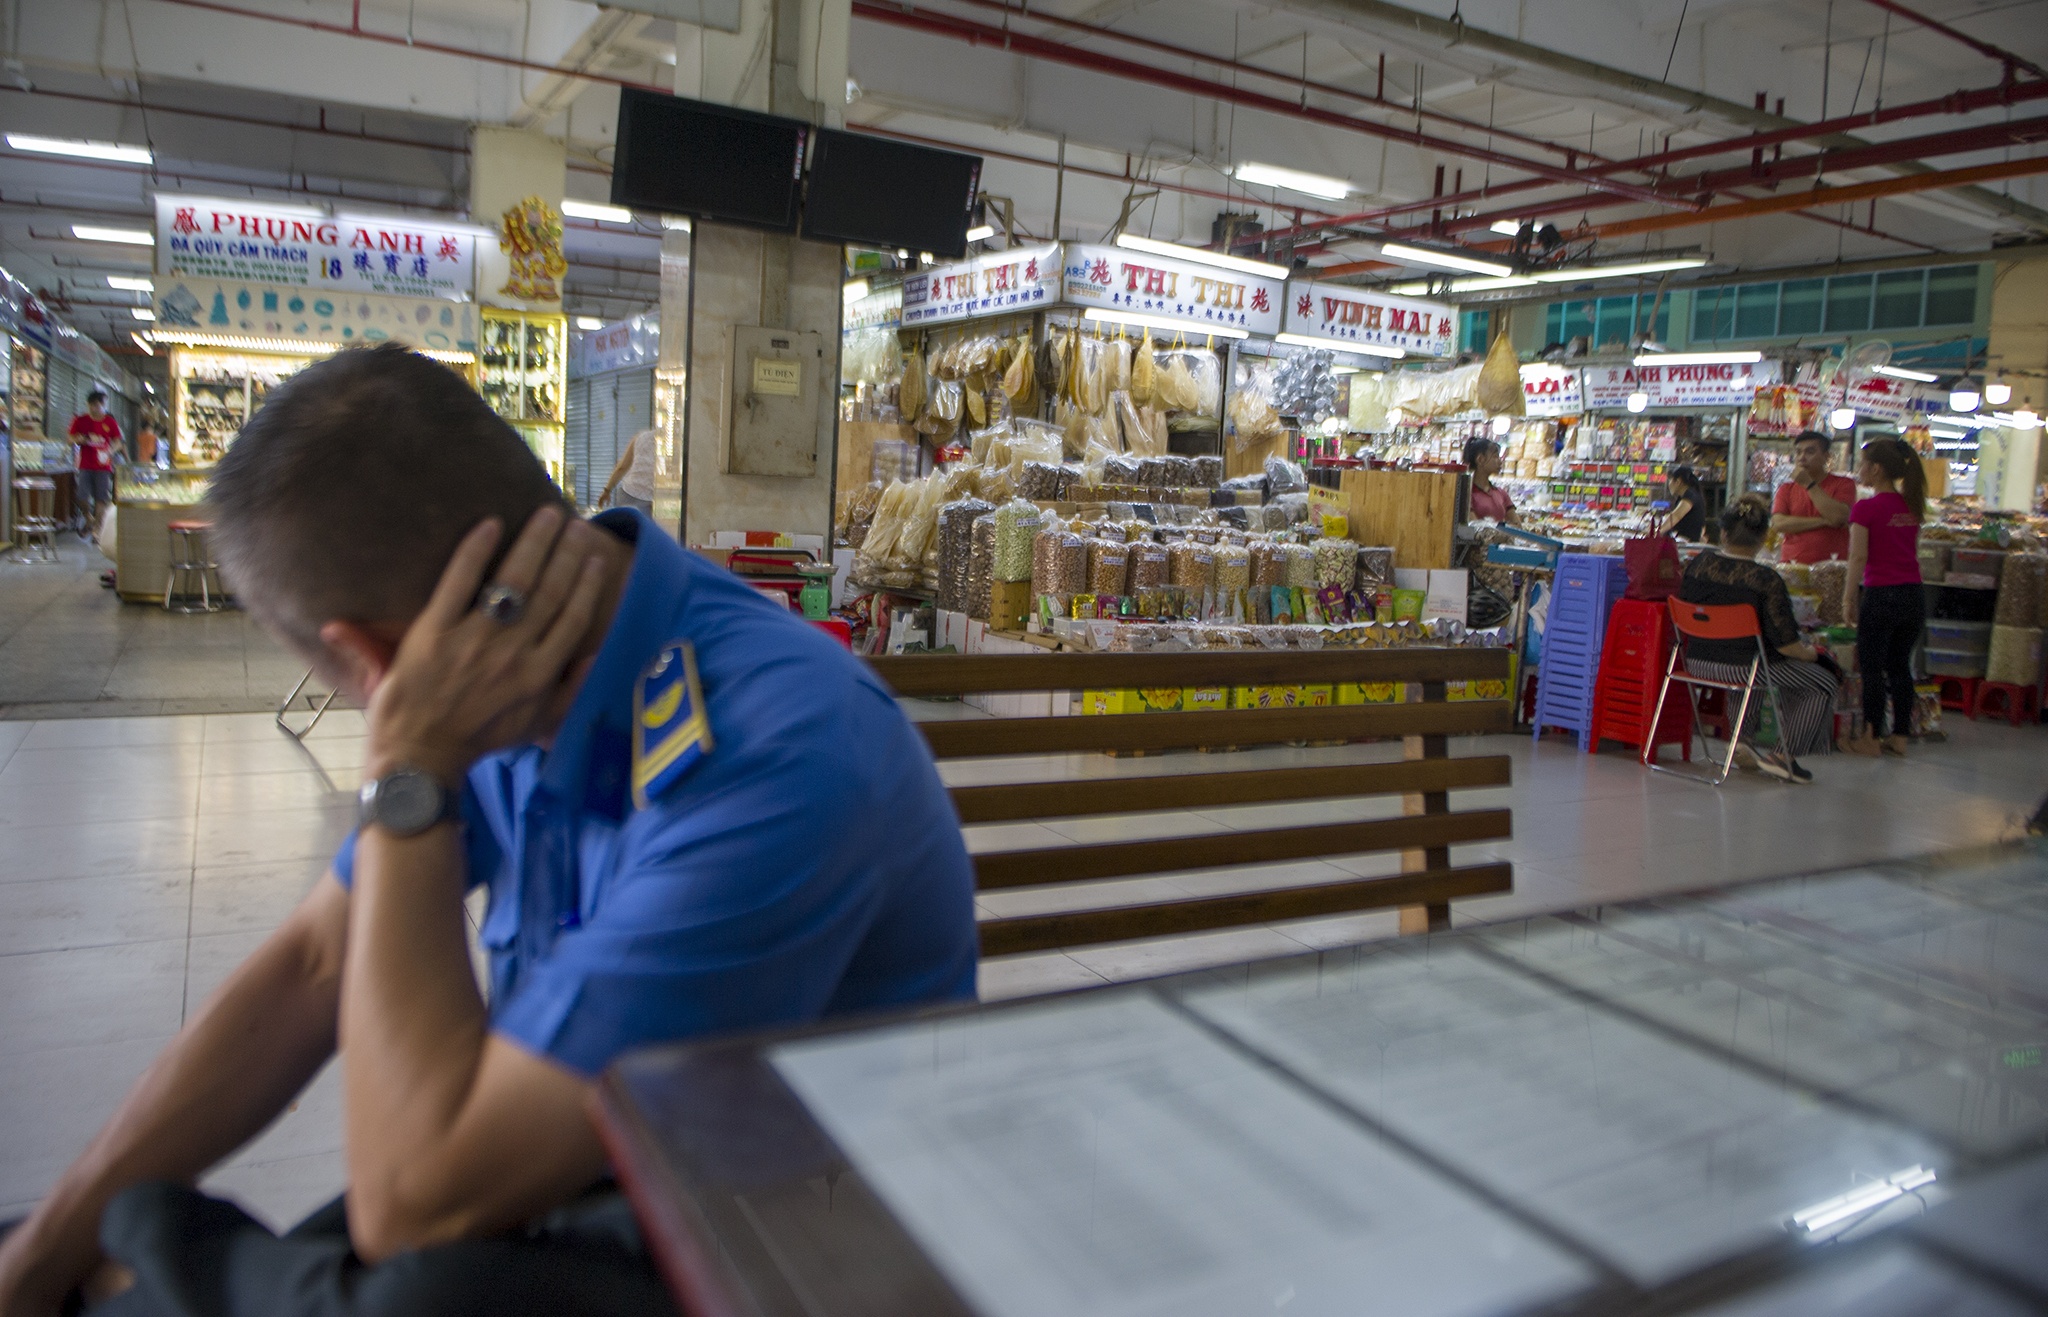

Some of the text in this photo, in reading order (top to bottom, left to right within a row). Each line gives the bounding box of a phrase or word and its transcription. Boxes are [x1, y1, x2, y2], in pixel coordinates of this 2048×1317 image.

[211, 211, 425, 255] PHỤNG ANH
[320, 256, 343, 280] 18
[945, 272, 978, 300] THI
[983, 263, 1019, 294] THI
[1121, 262, 1246, 310] THI THI
[1321, 297, 1433, 336] VINH MAI
[1622, 364, 1734, 385] ANH PHỤNG
